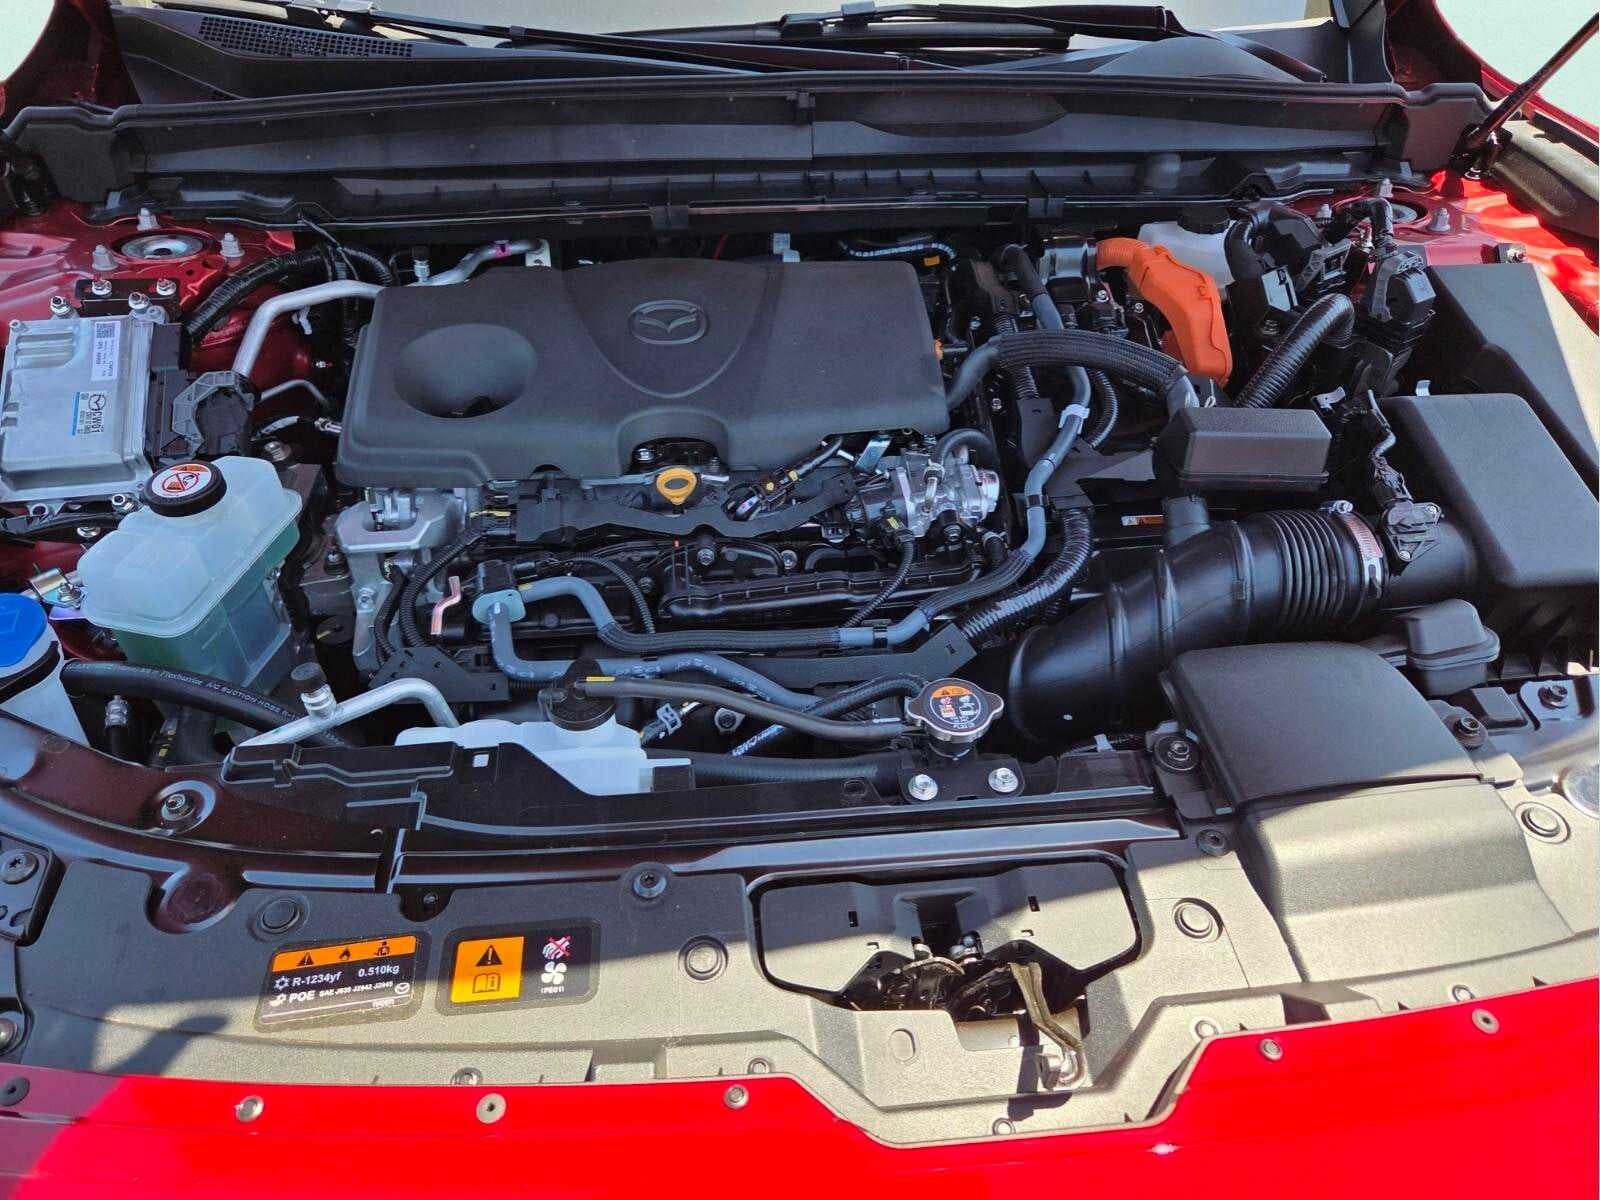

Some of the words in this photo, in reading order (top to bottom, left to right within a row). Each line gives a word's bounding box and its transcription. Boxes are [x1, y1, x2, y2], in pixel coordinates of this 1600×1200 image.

[292, 971, 342, 988] R-1234yf
[358, 964, 400, 978] 0.510kg
[288, 990, 316, 1004] POE
